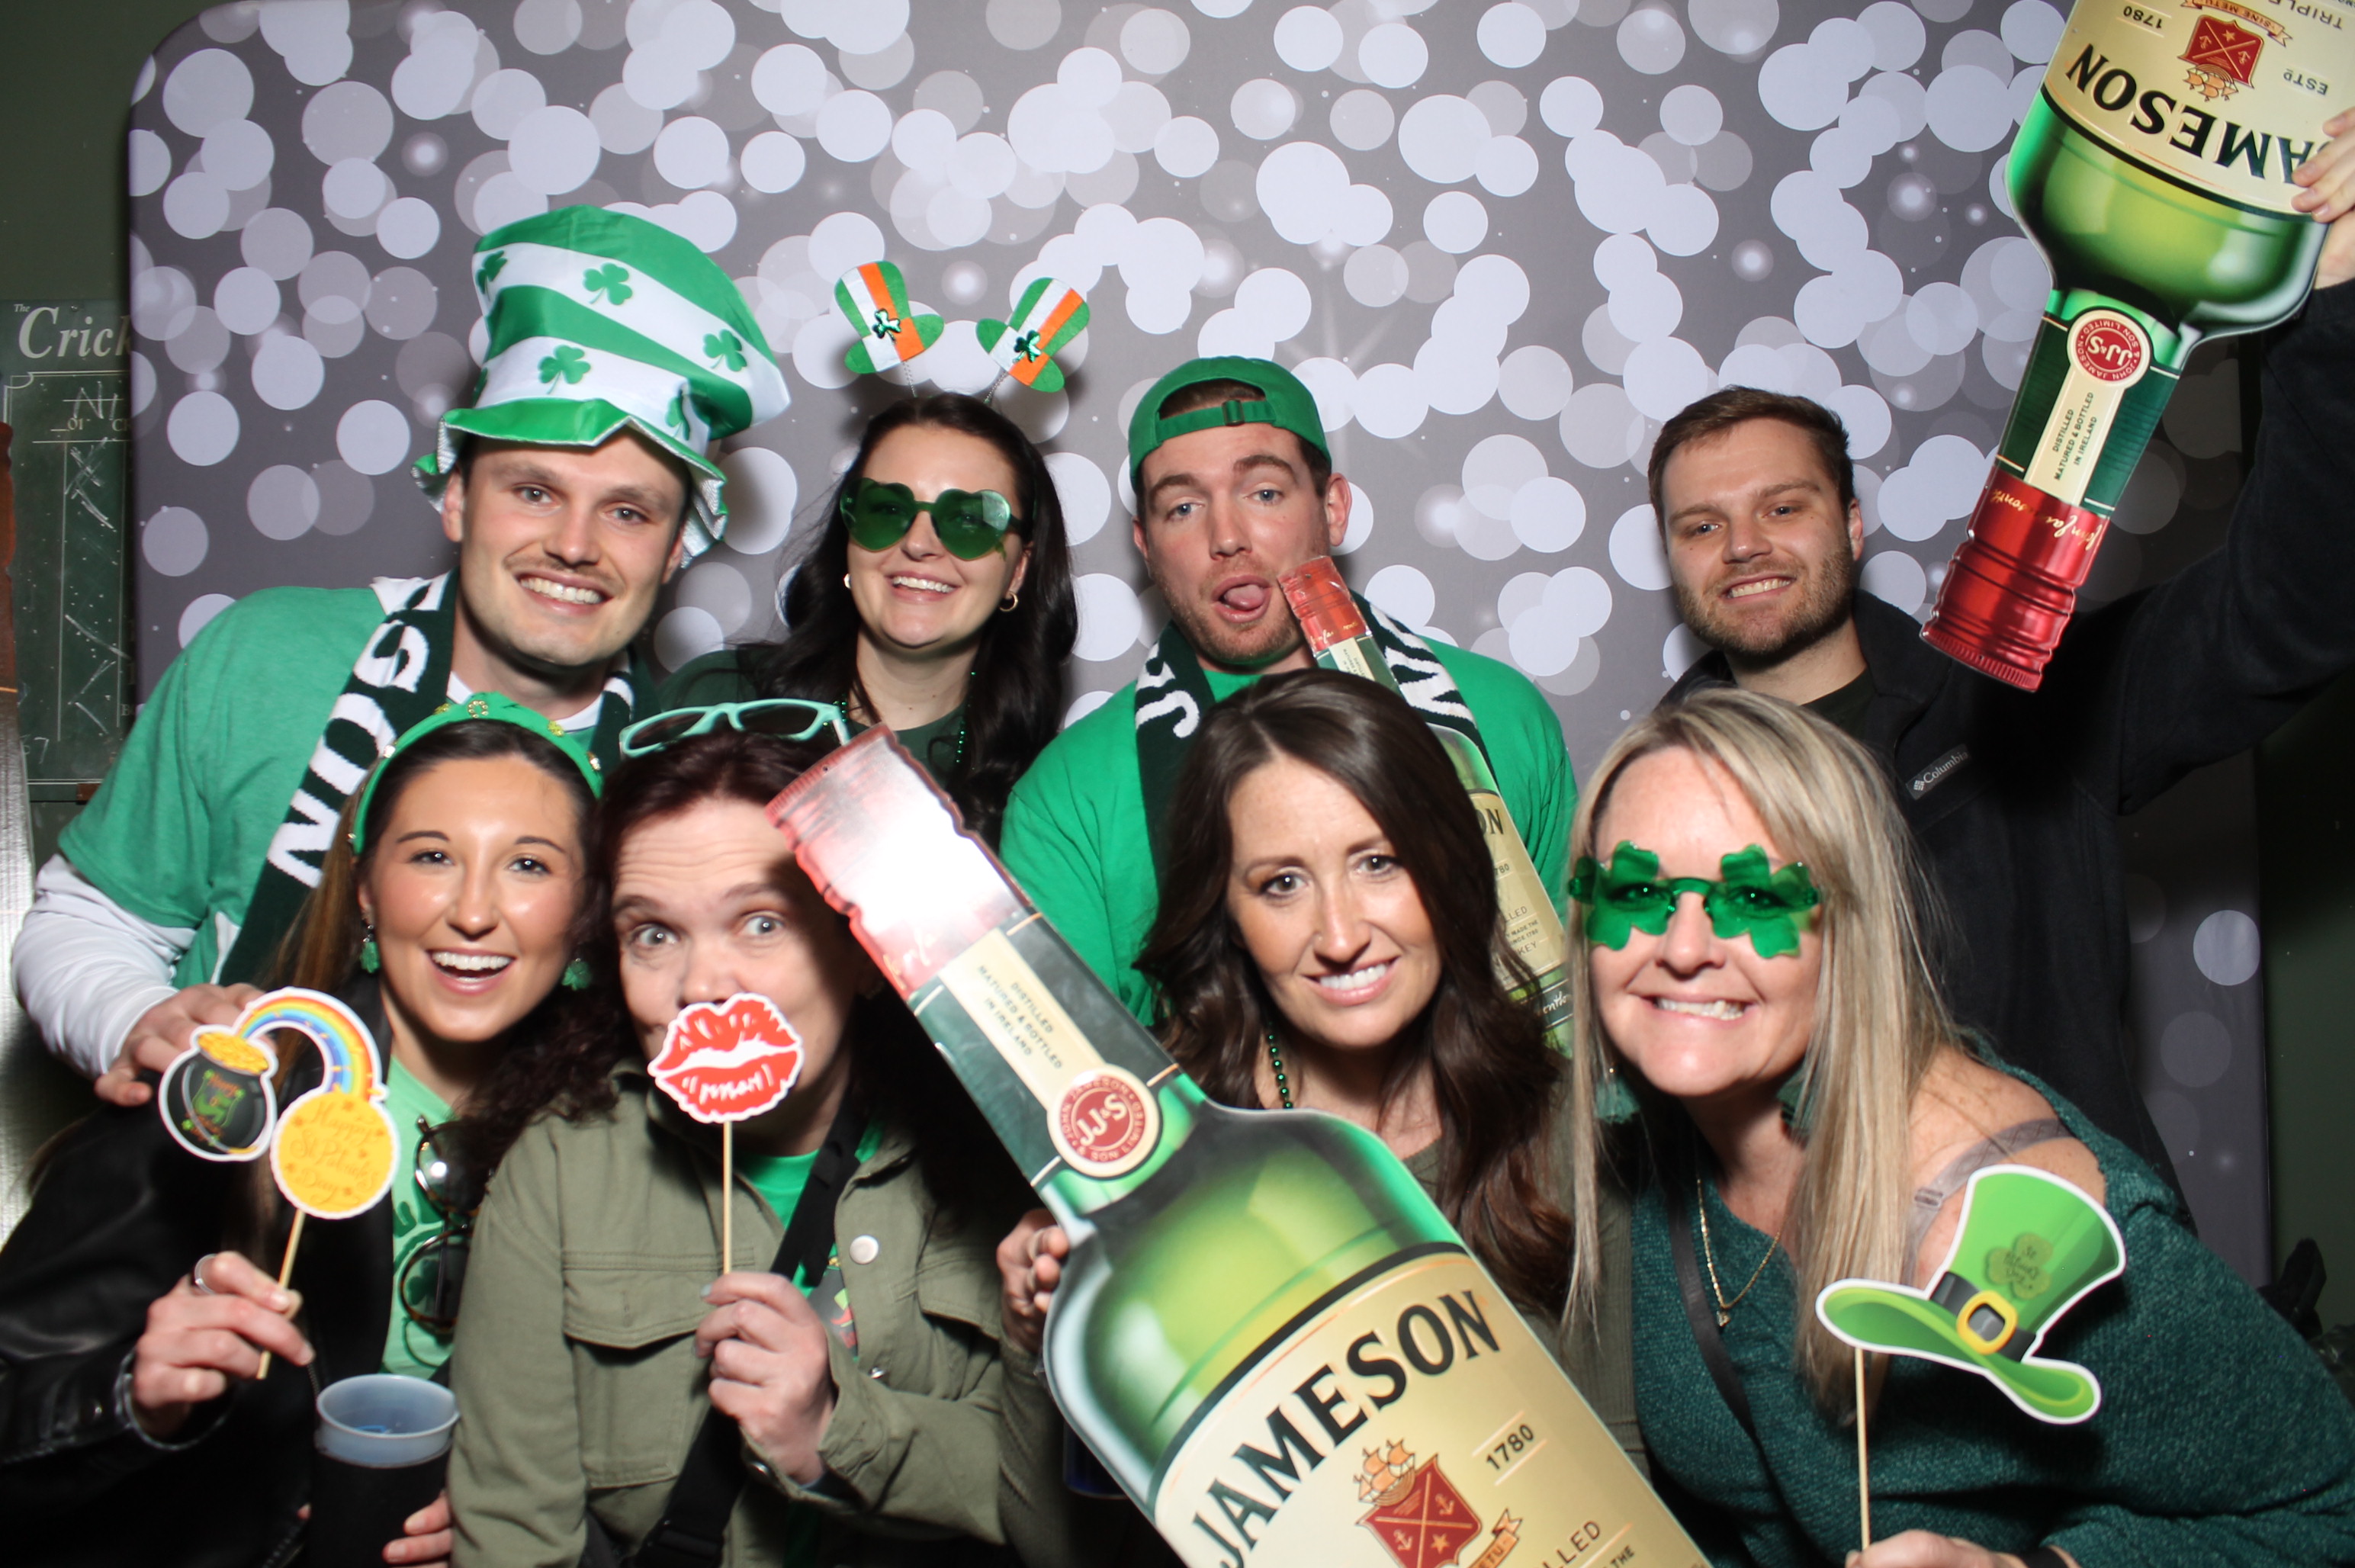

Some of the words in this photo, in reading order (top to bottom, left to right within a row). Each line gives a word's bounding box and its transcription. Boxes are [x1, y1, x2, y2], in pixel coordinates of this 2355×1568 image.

[2122, 6, 2164, 30] 1780
[2065, 43, 2329, 185] AMESON
[14, 304, 31, 313] The
[2082, 320, 2121, 335] LIMITED
[2087, 336, 2134, 366] JJ&S
[2122, 328, 2139, 348] SON
[2077, 340, 2109, 379] JAMESON
[2112, 362, 2137, 381] JOHN
[2052, 409, 2074, 452] DISTILLED
[2054, 439, 2075, 481] MATURED
[2074, 391, 2094, 431] BOTTLED
[2077, 416, 2097, 455] IRELAND
[2074, 455, 2083, 466] IN
[1923, 751, 1968, 784] Columbia
[1492, 863, 1510, 876] 780
[978, 966, 1018, 1014] MATURED
[1024, 1023, 1062, 1068] BOTTLED
[984, 998, 995, 1010] IN
[994, 1010, 1032, 1056] IRELAND
[1010, 982, 1053, 1033] DISTILLED
[1190, 1289, 1502, 1568] JAMESON
[1484, 1423, 1535, 1472] 1780
